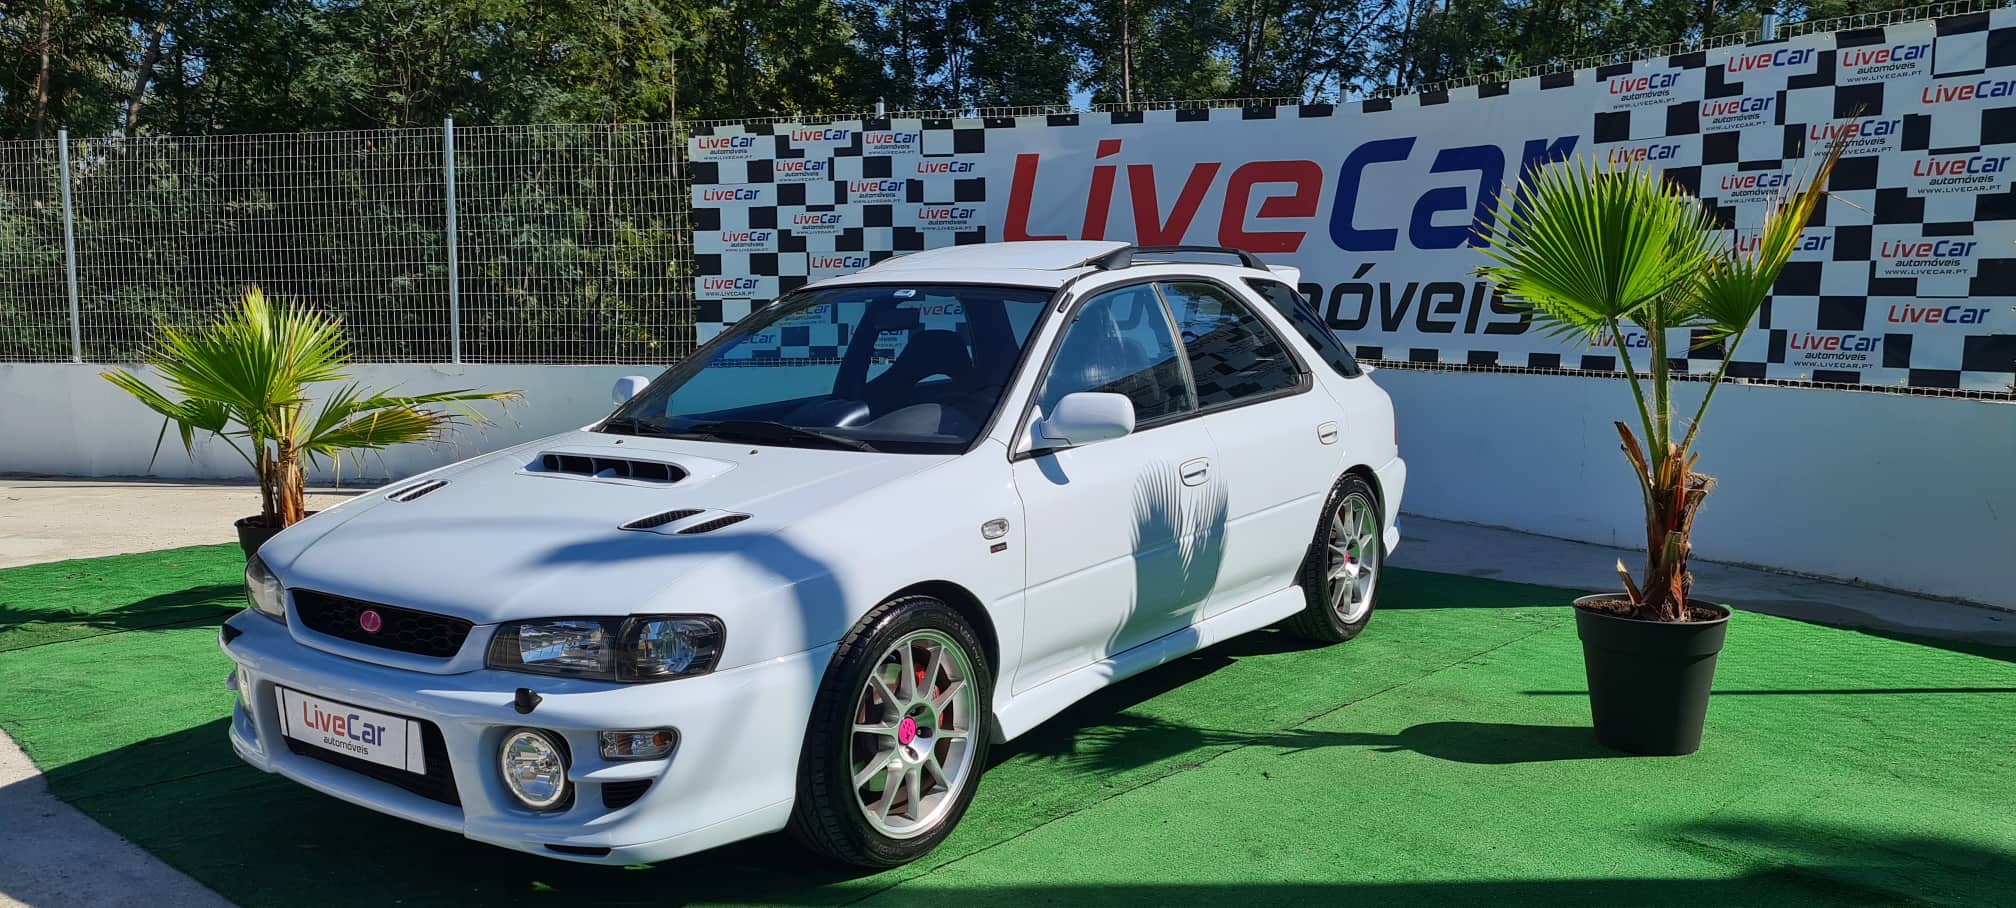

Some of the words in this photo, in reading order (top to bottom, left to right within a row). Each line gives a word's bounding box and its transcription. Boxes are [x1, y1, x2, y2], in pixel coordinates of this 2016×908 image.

[1728, 48, 1815, 72] LiveCar
[1843, 44, 1930, 67] LiveCar
[1857, 61, 1916, 74] automóveis
[1610, 72, 1680, 94] LiveCar
[1846, 70, 1922, 83] WWW.LIVECAR.PT
[1620, 89, 1670, 102] automóveis
[1702, 97, 1774, 117] LiveCar
[1712, 112, 1760, 124] automóveis
[1706, 121, 1767, 131] WWW.LIVECAR.PT
[1810, 120, 1901, 141] LiveCar
[791, 128, 849, 142] LiveCar
[865, 132, 918, 144] LiveCar
[698, 136, 756, 149] LiveCar
[776, 160, 826, 172] LiveCar
[917, 161, 975, 173] LiveCar
[1914, 156, 2010, 177] LiveCar
[850, 180, 905, 192] LiveCar
[1721, 174, 1792, 190] LiveCar
[1929, 174, 1994, 186] automóveis
[704, 188, 760, 201] LiveCar
[1918, 185, 2001, 194] WWW.LIVECAR.PT
[793, 213, 843, 225] LiveCar
[918, 207, 976, 220] LiveCar
[722, 230, 772, 242] LiveCar
[1881, 240, 1977, 258] LiveCar
[812, 256, 868, 268] LiveCar
[1896, 258, 1960, 267] automóveis
[704, 276, 759, 290] LiveCar
[1888, 304, 1991, 324] LiveCar
[1790, 332, 1881, 352] LiveCar
[1804, 352, 1867, 360] automóveis
[304, 701, 385, 746] LiveCar
[323, 736, 368, 755] automóveis
